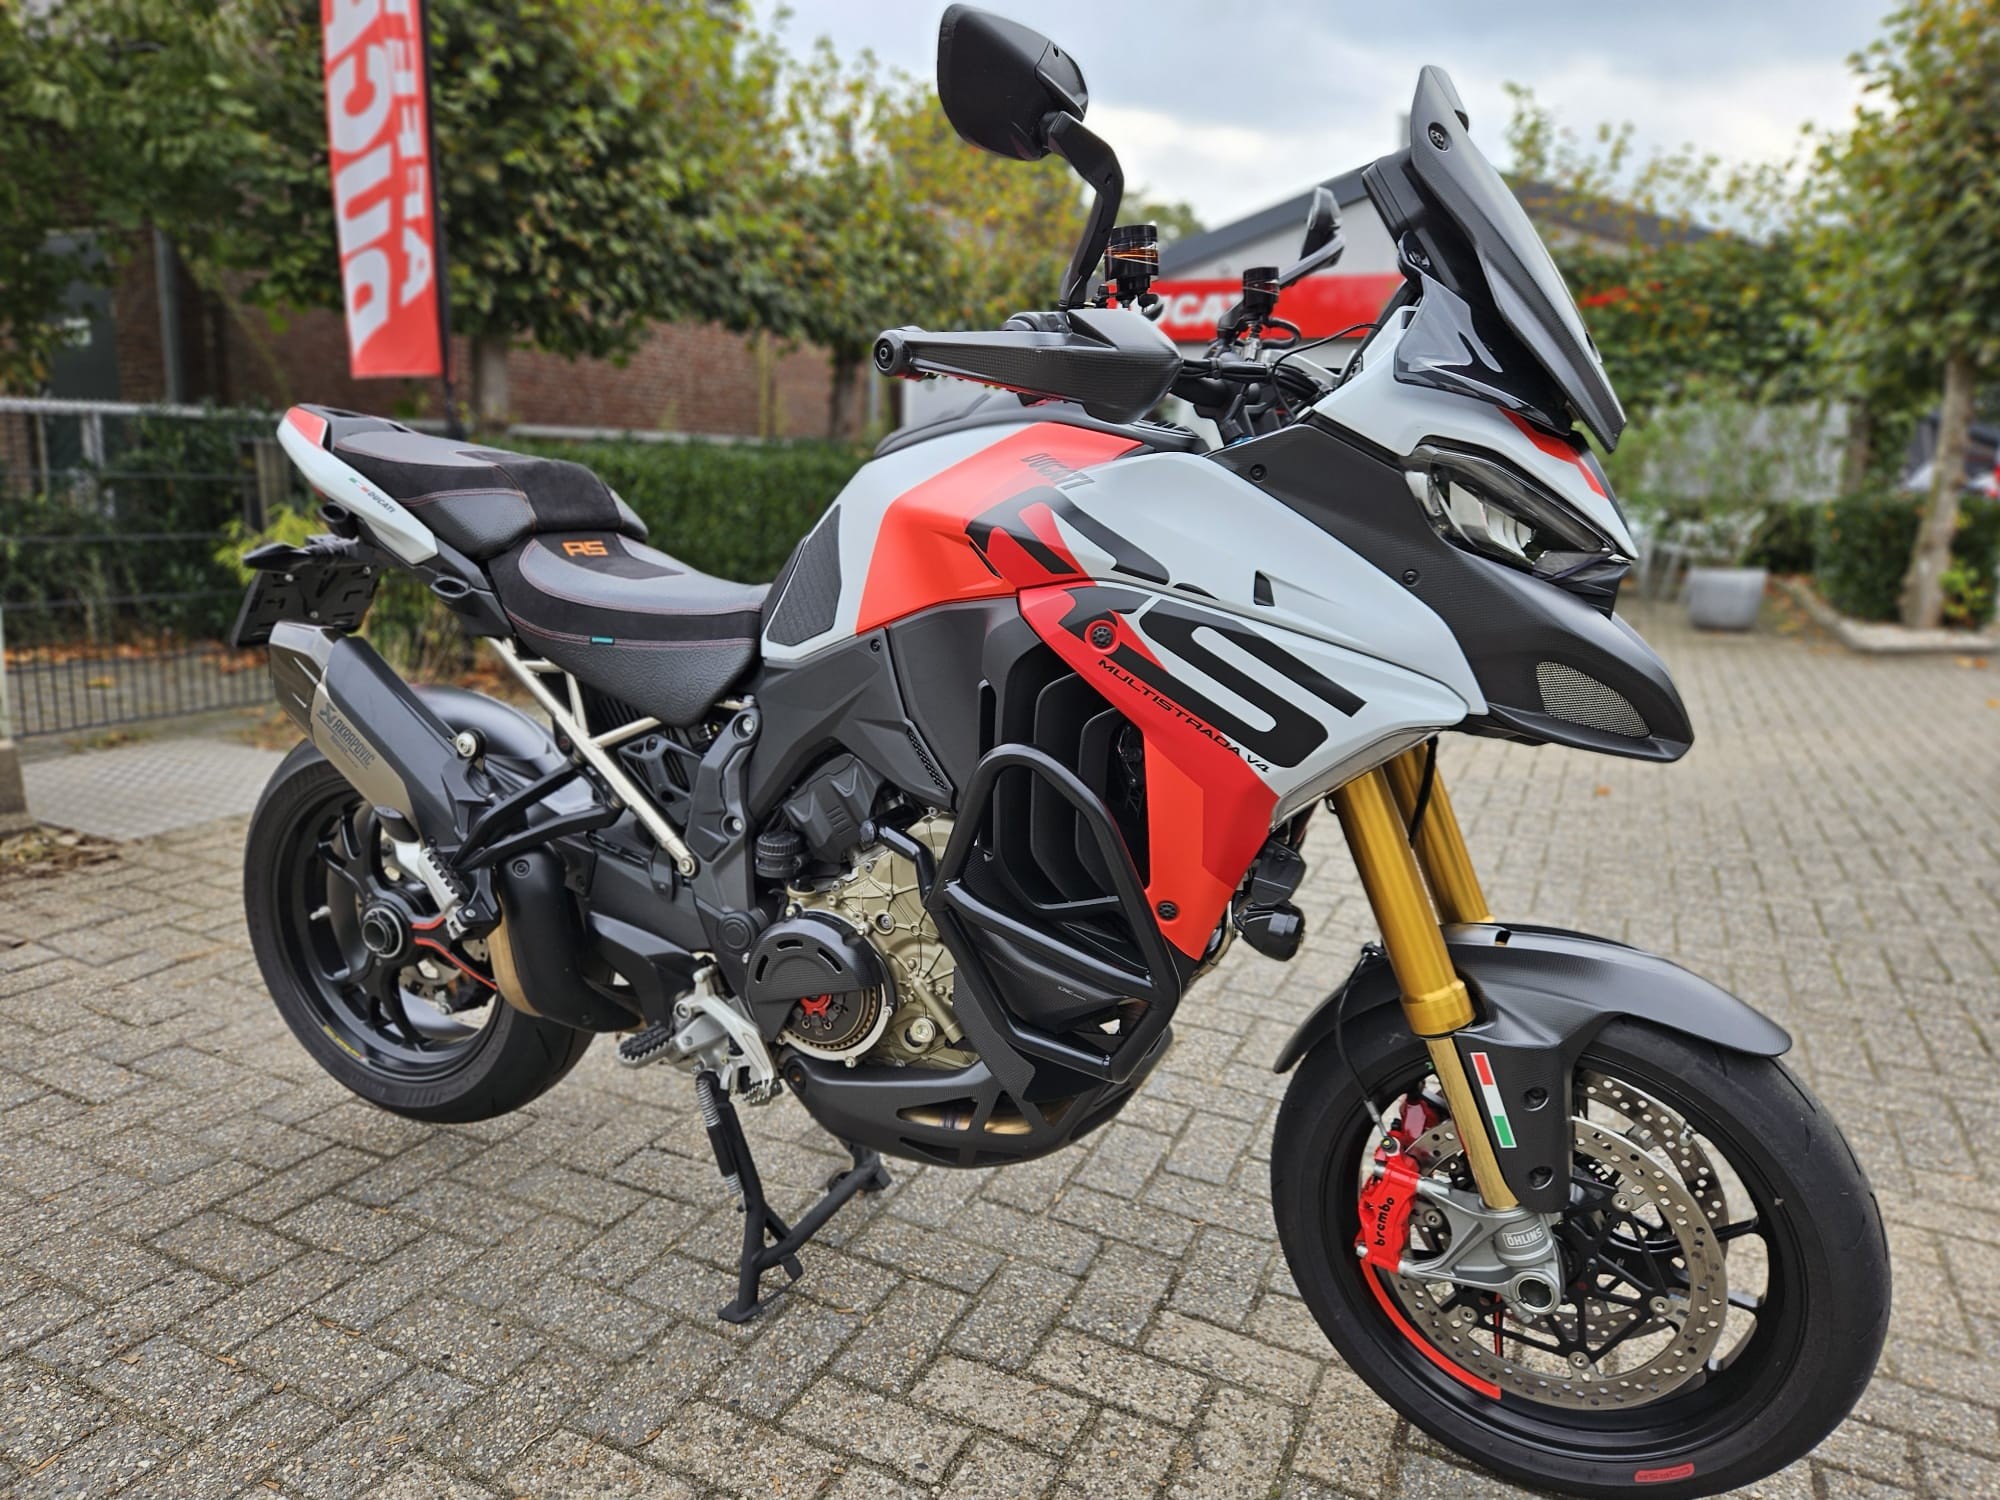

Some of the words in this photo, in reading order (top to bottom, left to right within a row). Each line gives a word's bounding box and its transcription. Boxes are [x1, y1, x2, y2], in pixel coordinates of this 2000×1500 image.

[1021, 452, 1096, 490] DUCATI
[367, 491, 396, 513] DUCATI
[562, 540, 609, 557] RS
[1098, 659, 1241, 756] MULTISTRADA
[1247, 754, 1270, 773] V4
[1373, 1197, 1395, 1247] brembo
